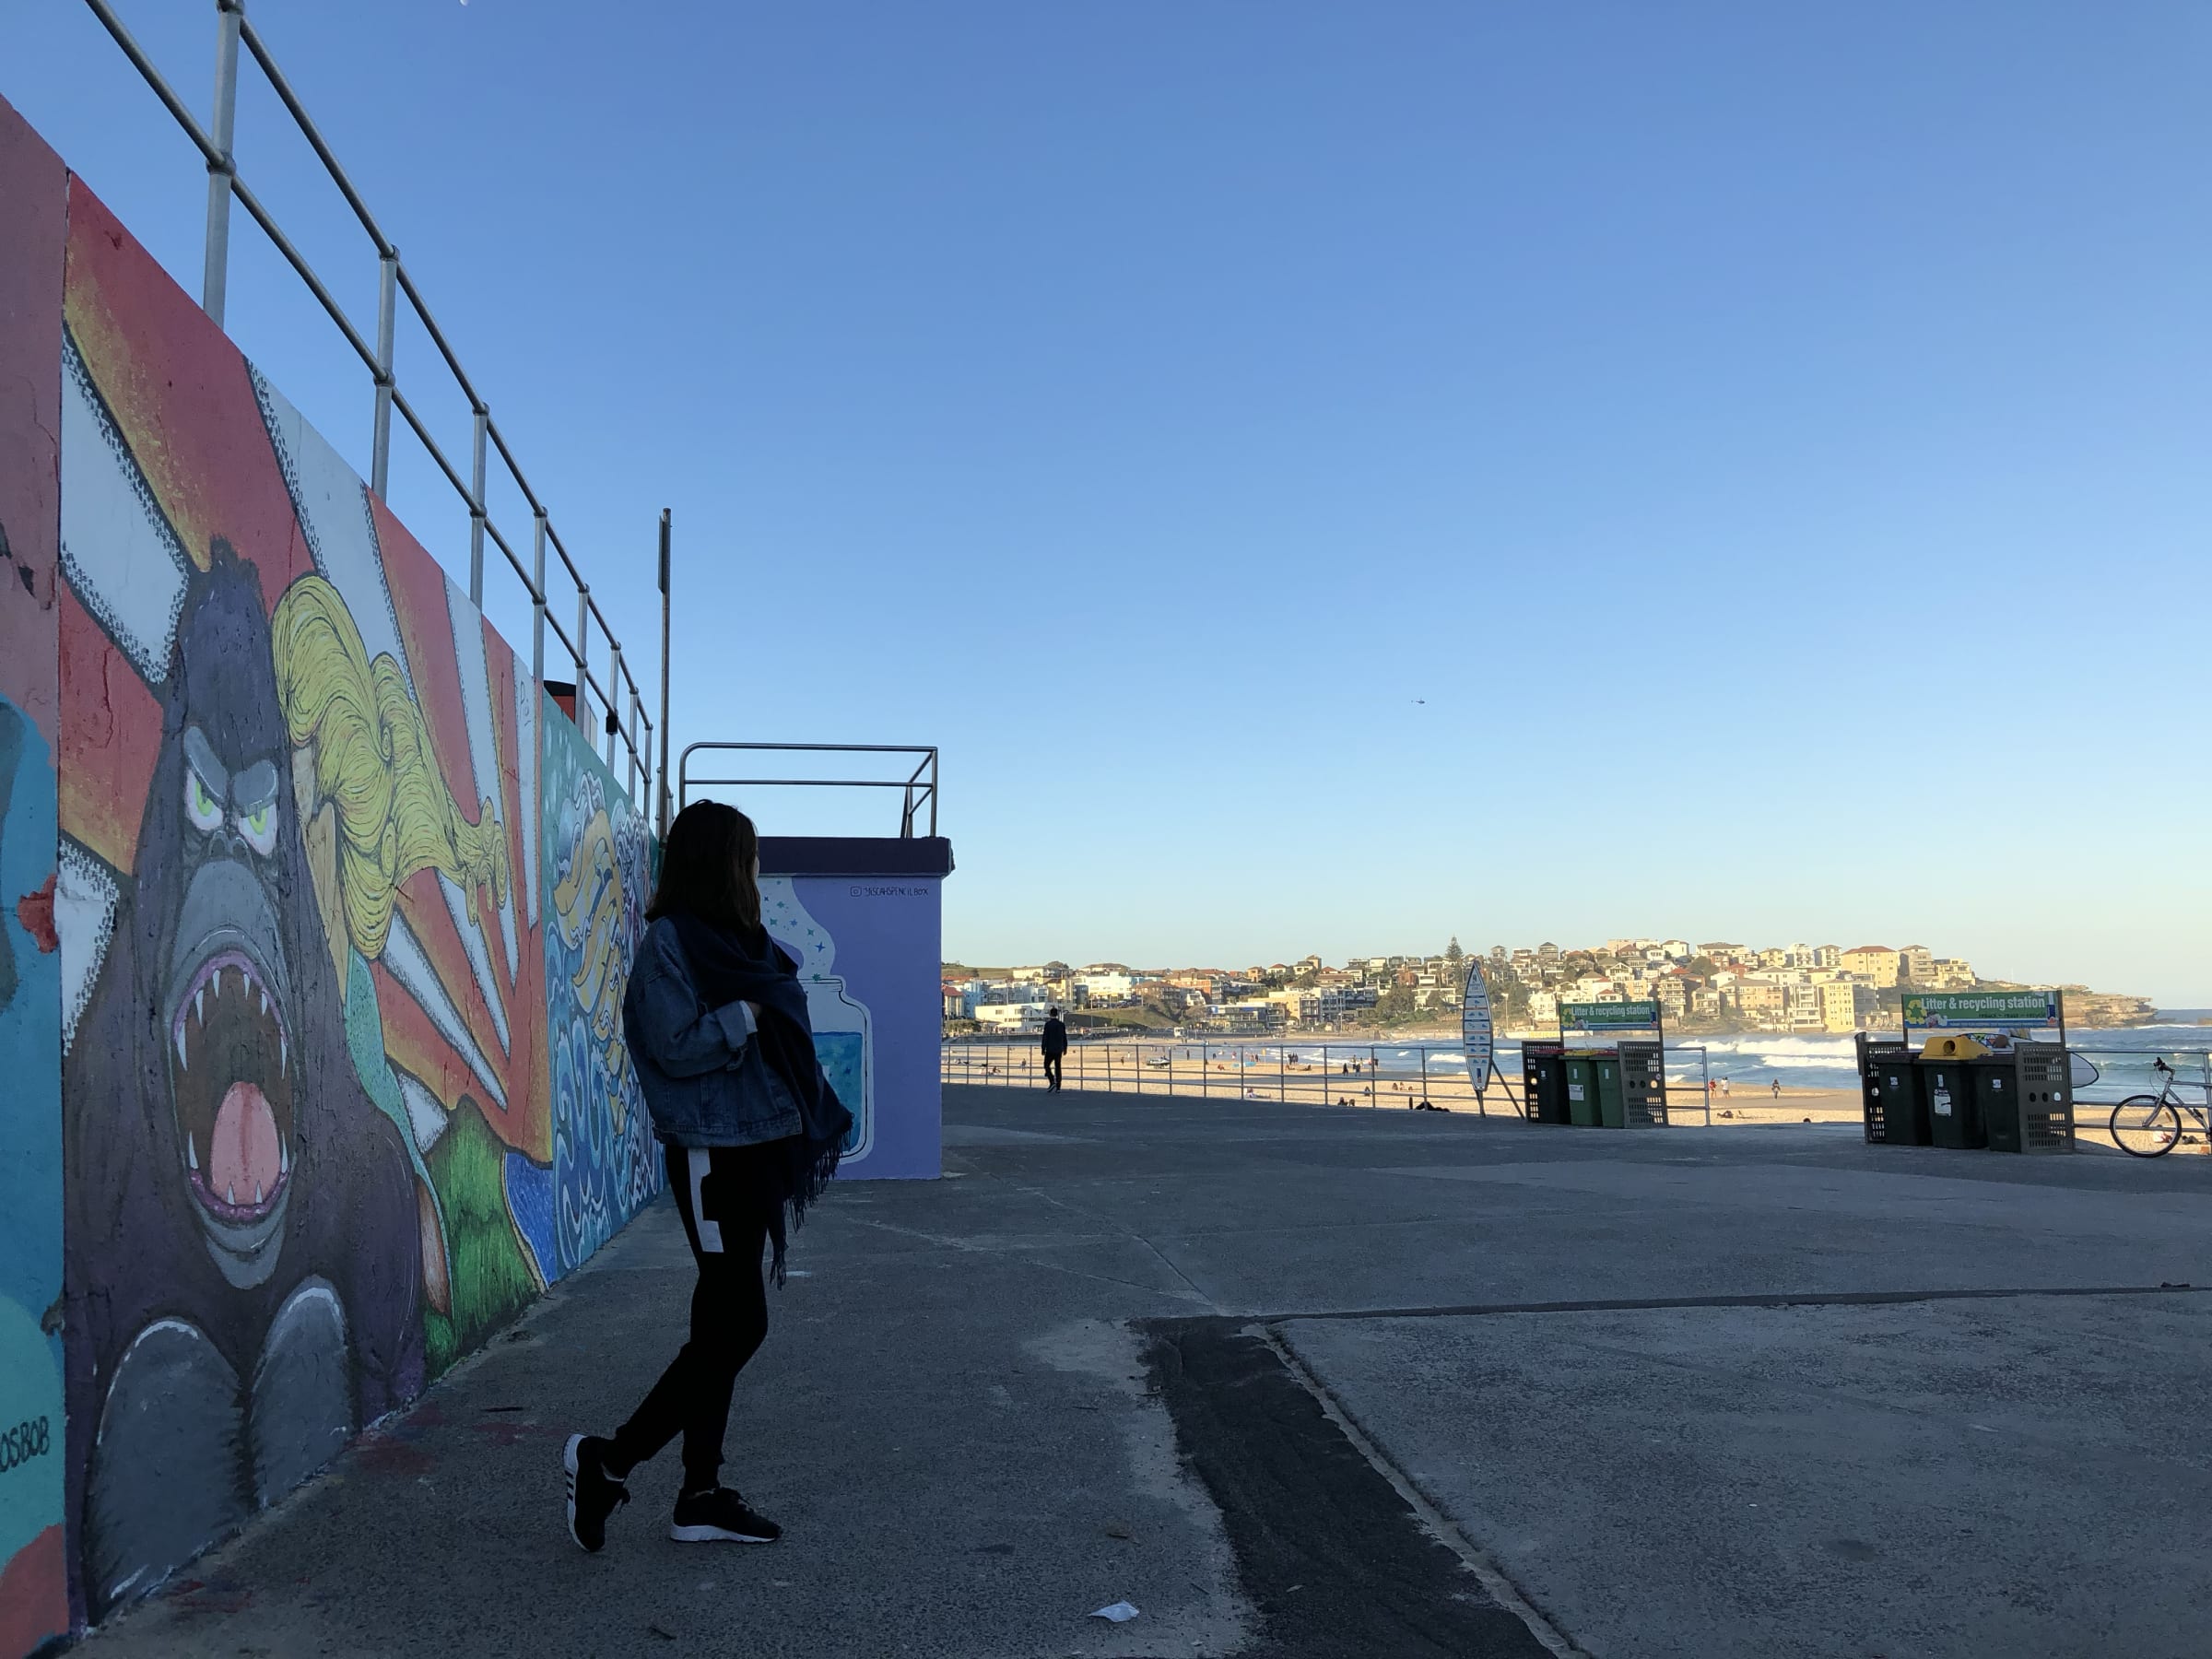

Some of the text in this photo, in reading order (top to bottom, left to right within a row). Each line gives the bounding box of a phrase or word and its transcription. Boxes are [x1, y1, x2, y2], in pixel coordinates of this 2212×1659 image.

[1921, 995, 2045, 1011] Litter & recycling station
[1571, 1004, 1650, 1018] Litter & recycling station
